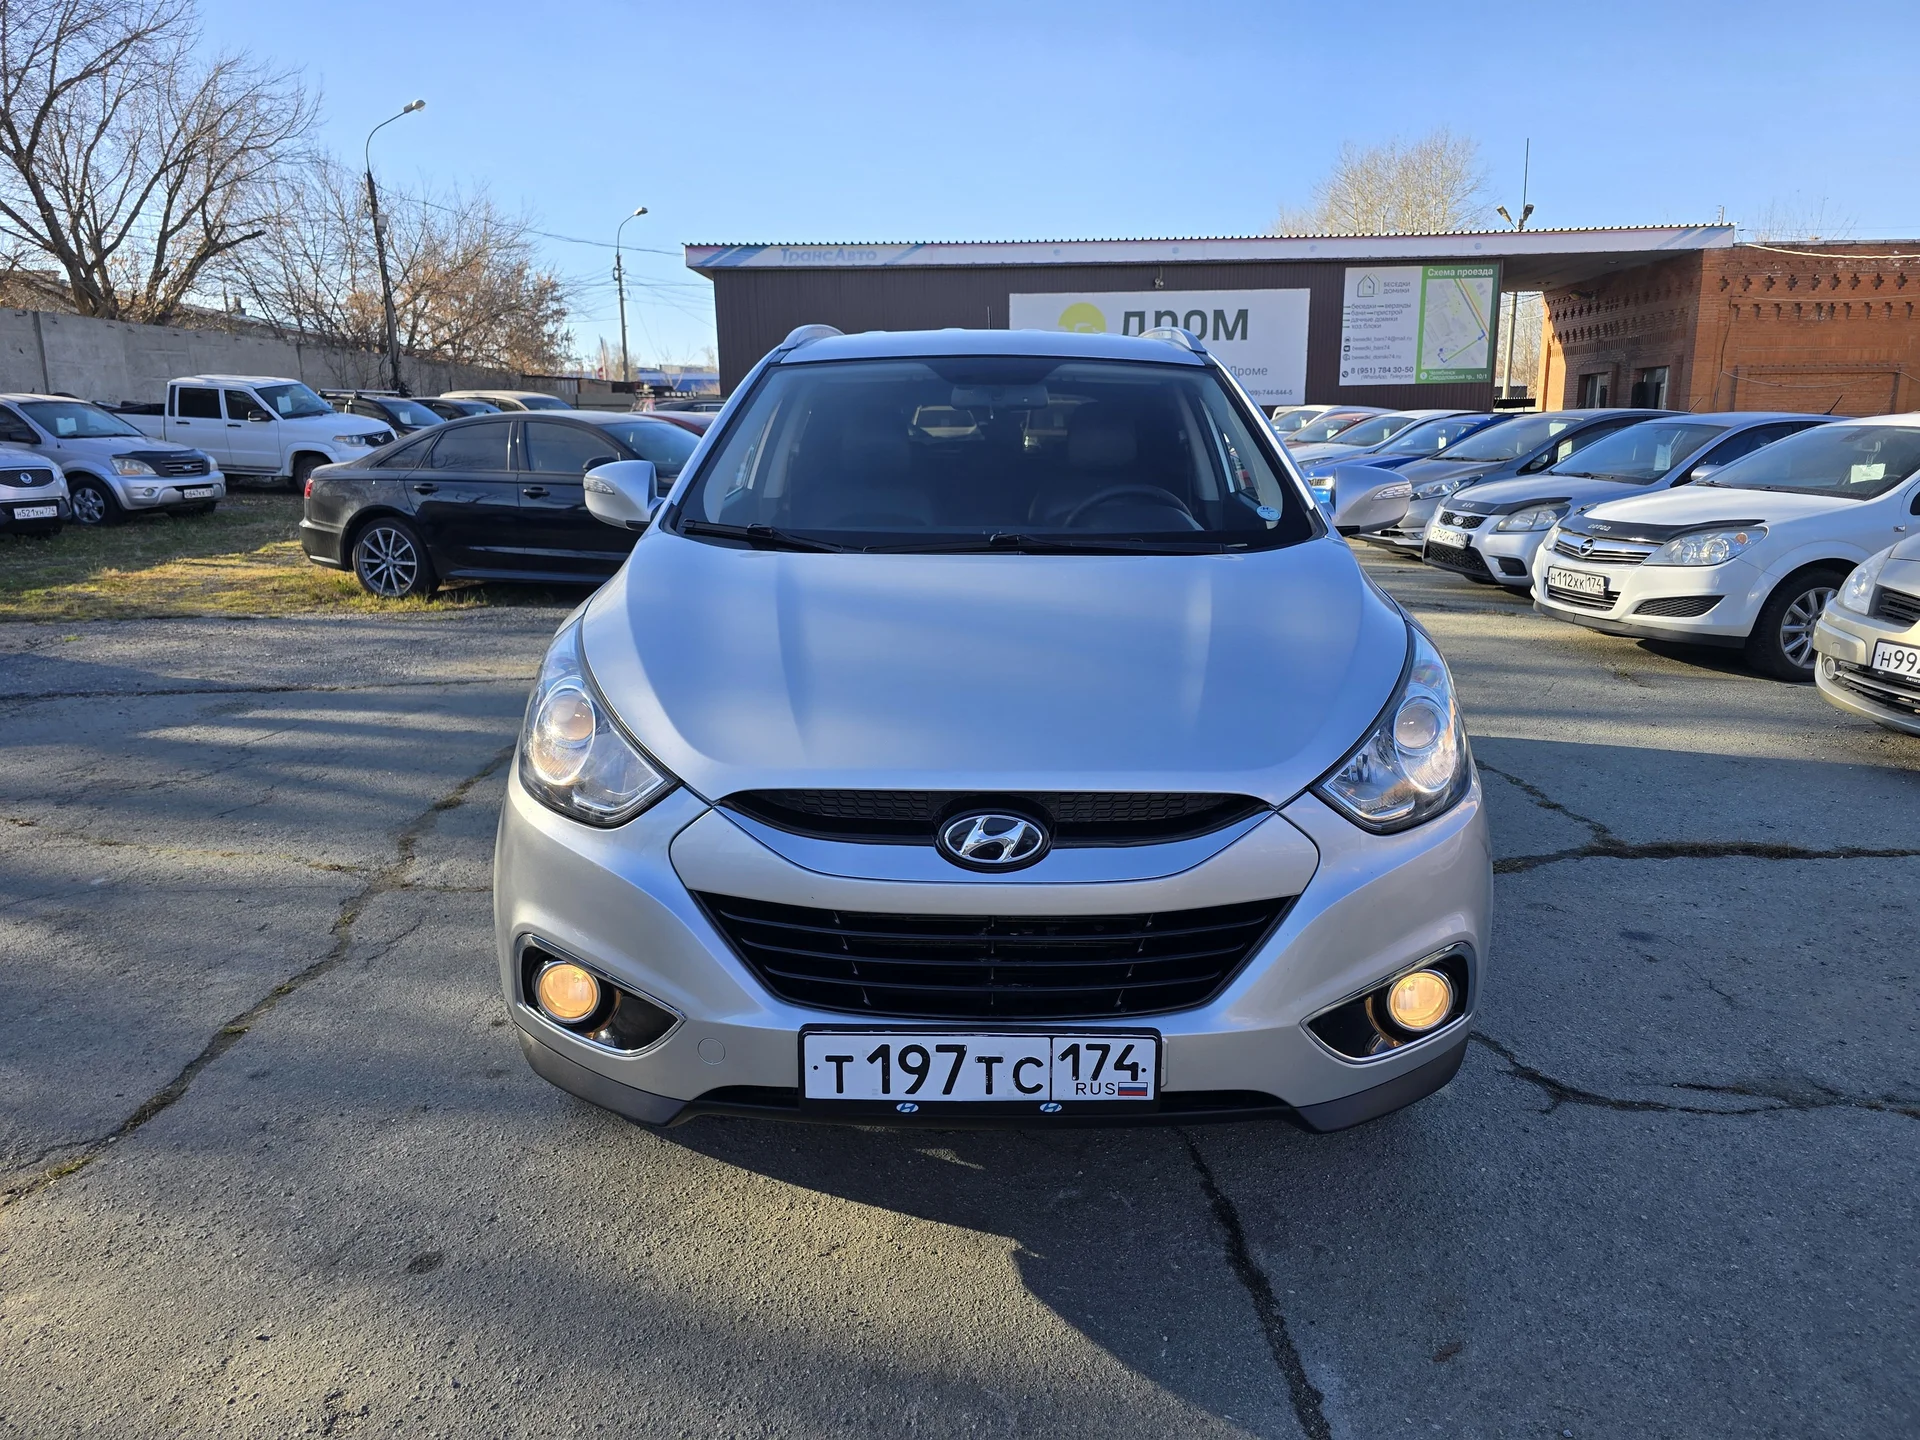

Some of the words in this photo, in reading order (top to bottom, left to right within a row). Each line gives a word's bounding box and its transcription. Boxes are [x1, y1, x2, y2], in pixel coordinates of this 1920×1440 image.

[1428, 268, 1455, 276] Схема
[1456, 268, 1493, 278] проезда
[1357, 366, 1376, 375] (951)
[1378, 366, 1391, 374] 784
[1550, 571, 1585, 591] Н112ХК
[1586, 576, 1602, 590] 174
[1879, 649, 1920, 674] Н99
[825, 1043, 1045, 1095] Т197ТС
[1057, 1042, 1139, 1082] 174
[1075, 1082, 1116, 1096] RUS
